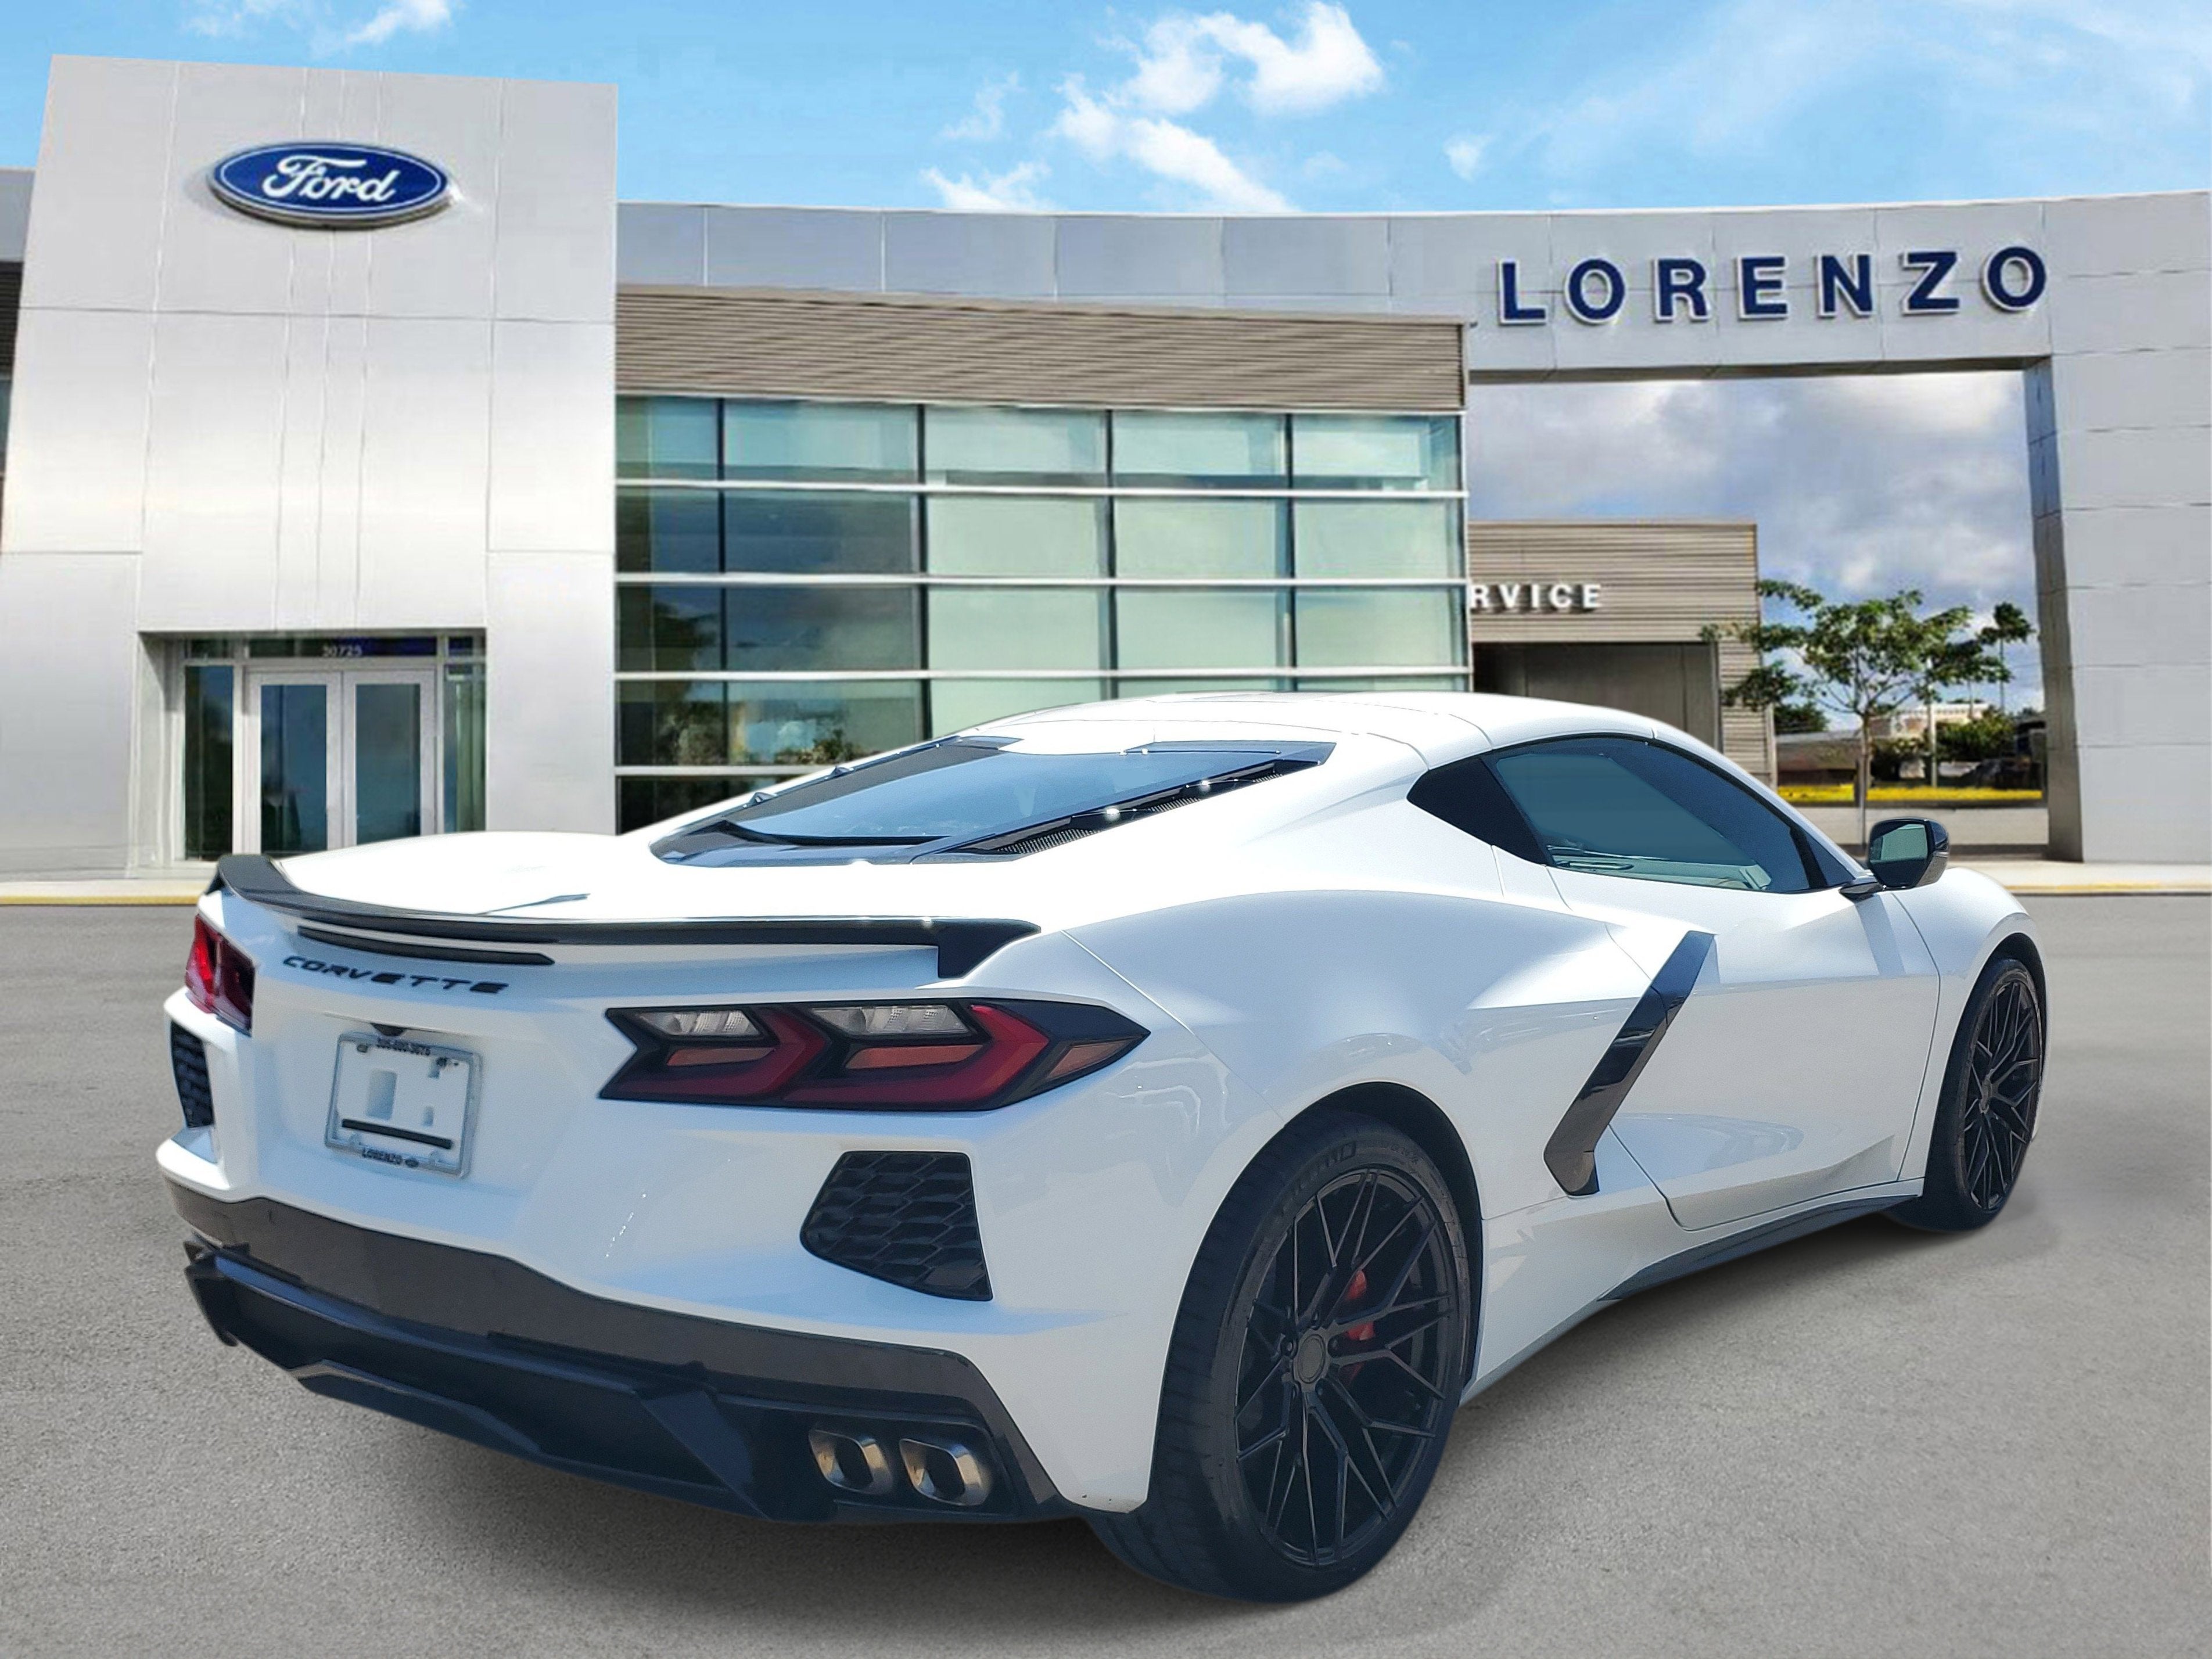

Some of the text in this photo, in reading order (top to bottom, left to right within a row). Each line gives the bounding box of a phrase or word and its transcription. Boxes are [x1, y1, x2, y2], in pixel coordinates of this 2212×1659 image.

[263, 155, 400, 202] Ford
[1498, 246, 2048, 325] LORENZO
[1470, 584, 1602, 608] RVICE
[283, 956, 509, 993] CORVETTE
